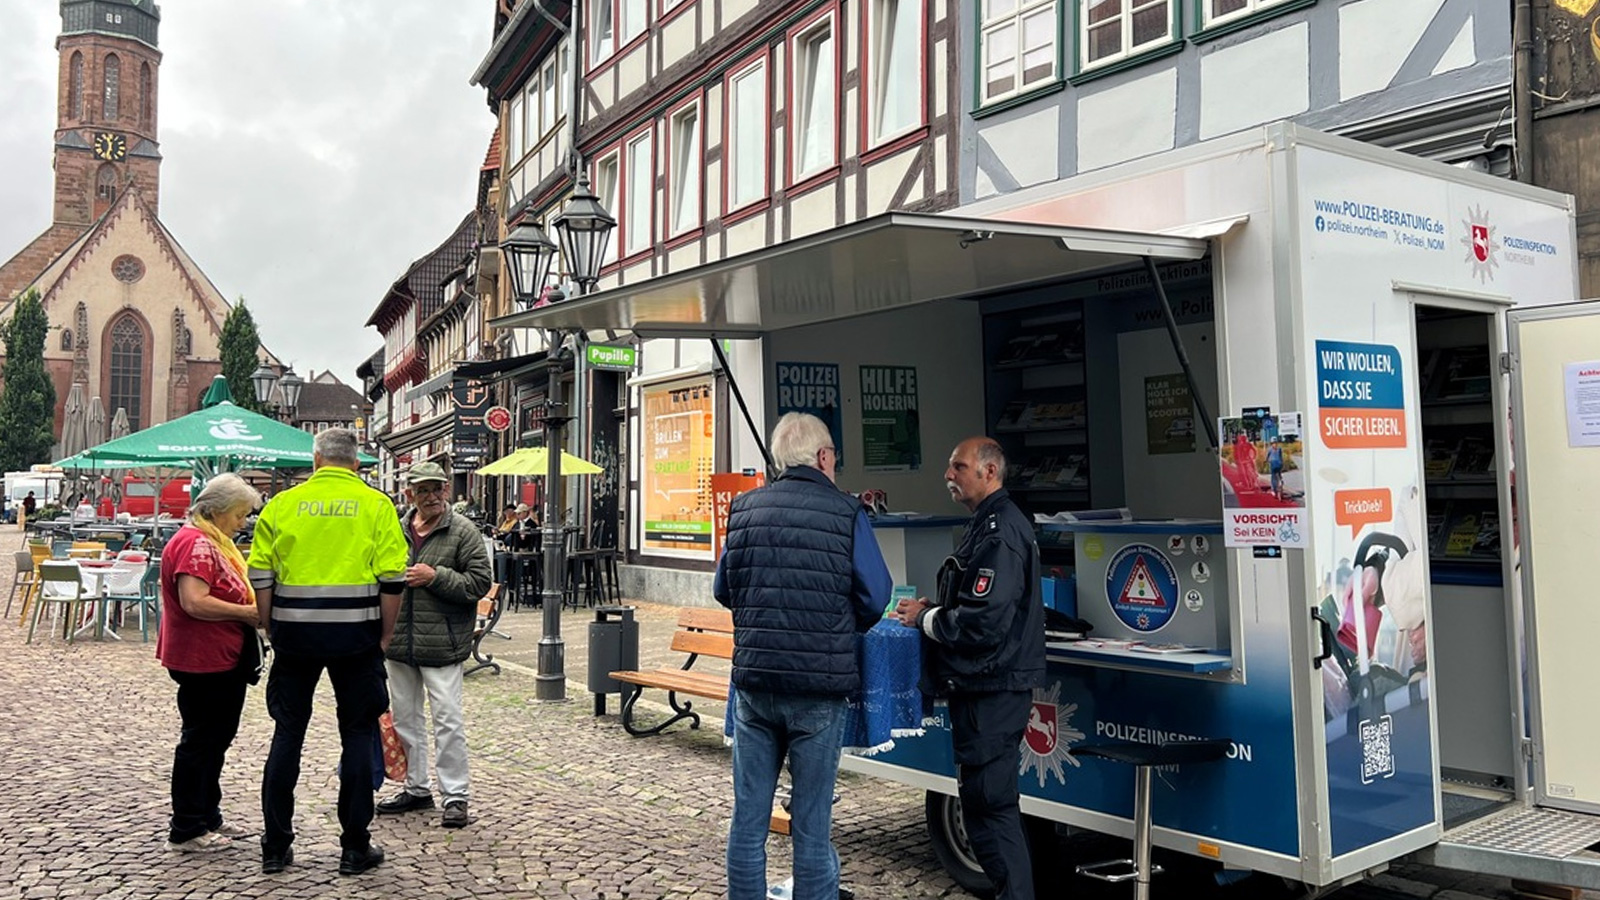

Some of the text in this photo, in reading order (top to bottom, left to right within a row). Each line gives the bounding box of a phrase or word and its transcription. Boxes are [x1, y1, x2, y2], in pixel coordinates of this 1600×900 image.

[1314, 199, 1444, 235] www.POLIZEI-BERATUNG.de
[1327, 219, 1388, 240] polizei.northeim
[1402, 233, 1445, 250] Polizei_NOM
[1503, 236, 1557, 255] POLIZEIINSPEKTION
[1504, 251, 1536, 267] NORTHEIM
[1097, 265, 1198, 291] Polizeiinsektion
[591, 348, 631, 362] Pupille
[1321, 351, 1395, 376] WIR WOLLEN,
[778, 365, 837, 385] POLIZEI
[861, 368, 916, 394] HILFE
[779, 385, 838, 408] RUFER
[1172, 387, 1188, 396] ICH
[1323, 380, 1372, 400] DASS SIE
[863, 394, 917, 411] HOLERIN
[1325, 417, 1402, 436] SICHER LEBEN.
[654, 429, 682, 445] BRILLEN
[297, 499, 359, 518] POLIZEI
[1343, 499, 1383, 514] TrickDieb!
[1233, 514, 1298, 524] VORSICHT!
[1233, 527, 1276, 537] Sei KEIN
